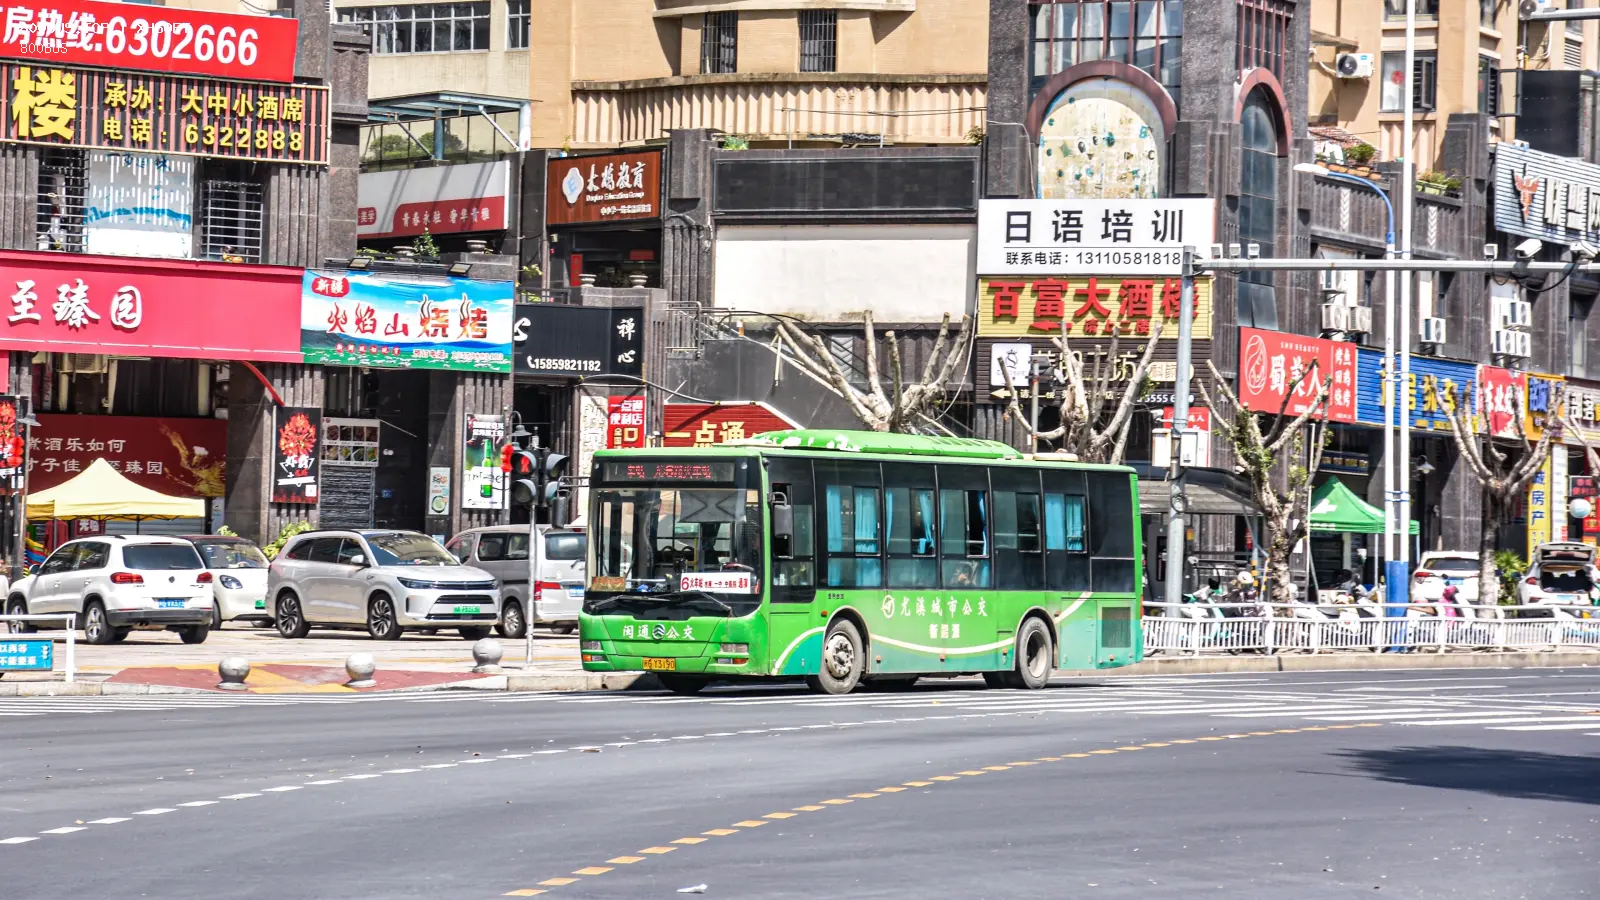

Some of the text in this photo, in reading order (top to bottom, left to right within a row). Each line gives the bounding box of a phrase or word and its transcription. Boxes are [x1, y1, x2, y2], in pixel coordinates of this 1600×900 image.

[0, 6, 258, 66] 房热线:6302666
[12, 67, 76, 140] 楼
[1005, 209, 1183, 243] 日语培训
[315, 278, 344, 294] 新疆
[7, 278, 142, 329] 至臻园
[988, 277, 1199, 318] 百富大酒楼
[327, 294, 488, 340] 火焰山烧烤
[617, 318, 635, 364] 禅心
[534, 358, 601, 372] 15859821182
[1269, 353, 1322, 397] 蜀美人
[610, 399, 643, 412] 一点通
[610, 412, 643, 425] 便利店
[665, 420, 745, 443] 一点通
[27, 458, 163, 475] 才子佳至臻园
[681, 577, 690, 591] 6
[900, 596, 988, 617] 尤溪城市公交
[622, 624, 695, 640] 闽通 公交
[929, 624, 960, 639] 新能源
